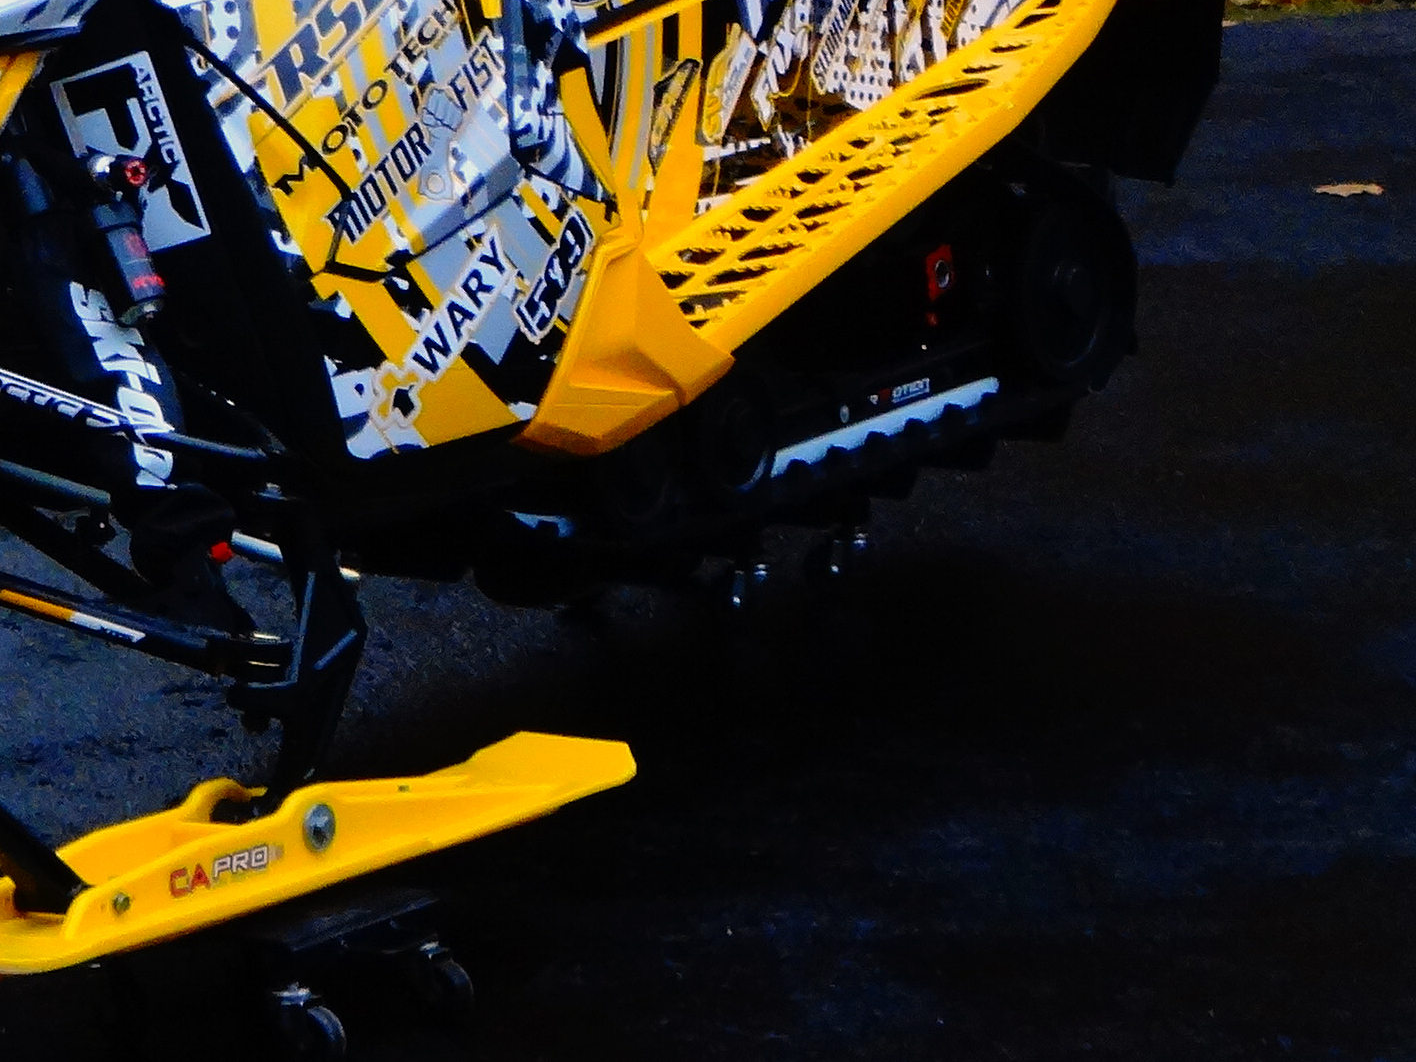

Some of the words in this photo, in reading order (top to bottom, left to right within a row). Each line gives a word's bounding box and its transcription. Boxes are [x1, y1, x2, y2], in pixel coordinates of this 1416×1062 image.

[134, 66, 178, 165] ARCTIC
[327, 121, 433, 244] MOTOR
[447, 34, 506, 113] FIST
[412, 236, 506, 375] WARY
[523, 216, 586, 332] 509
[212, 843, 269, 880] PRO
